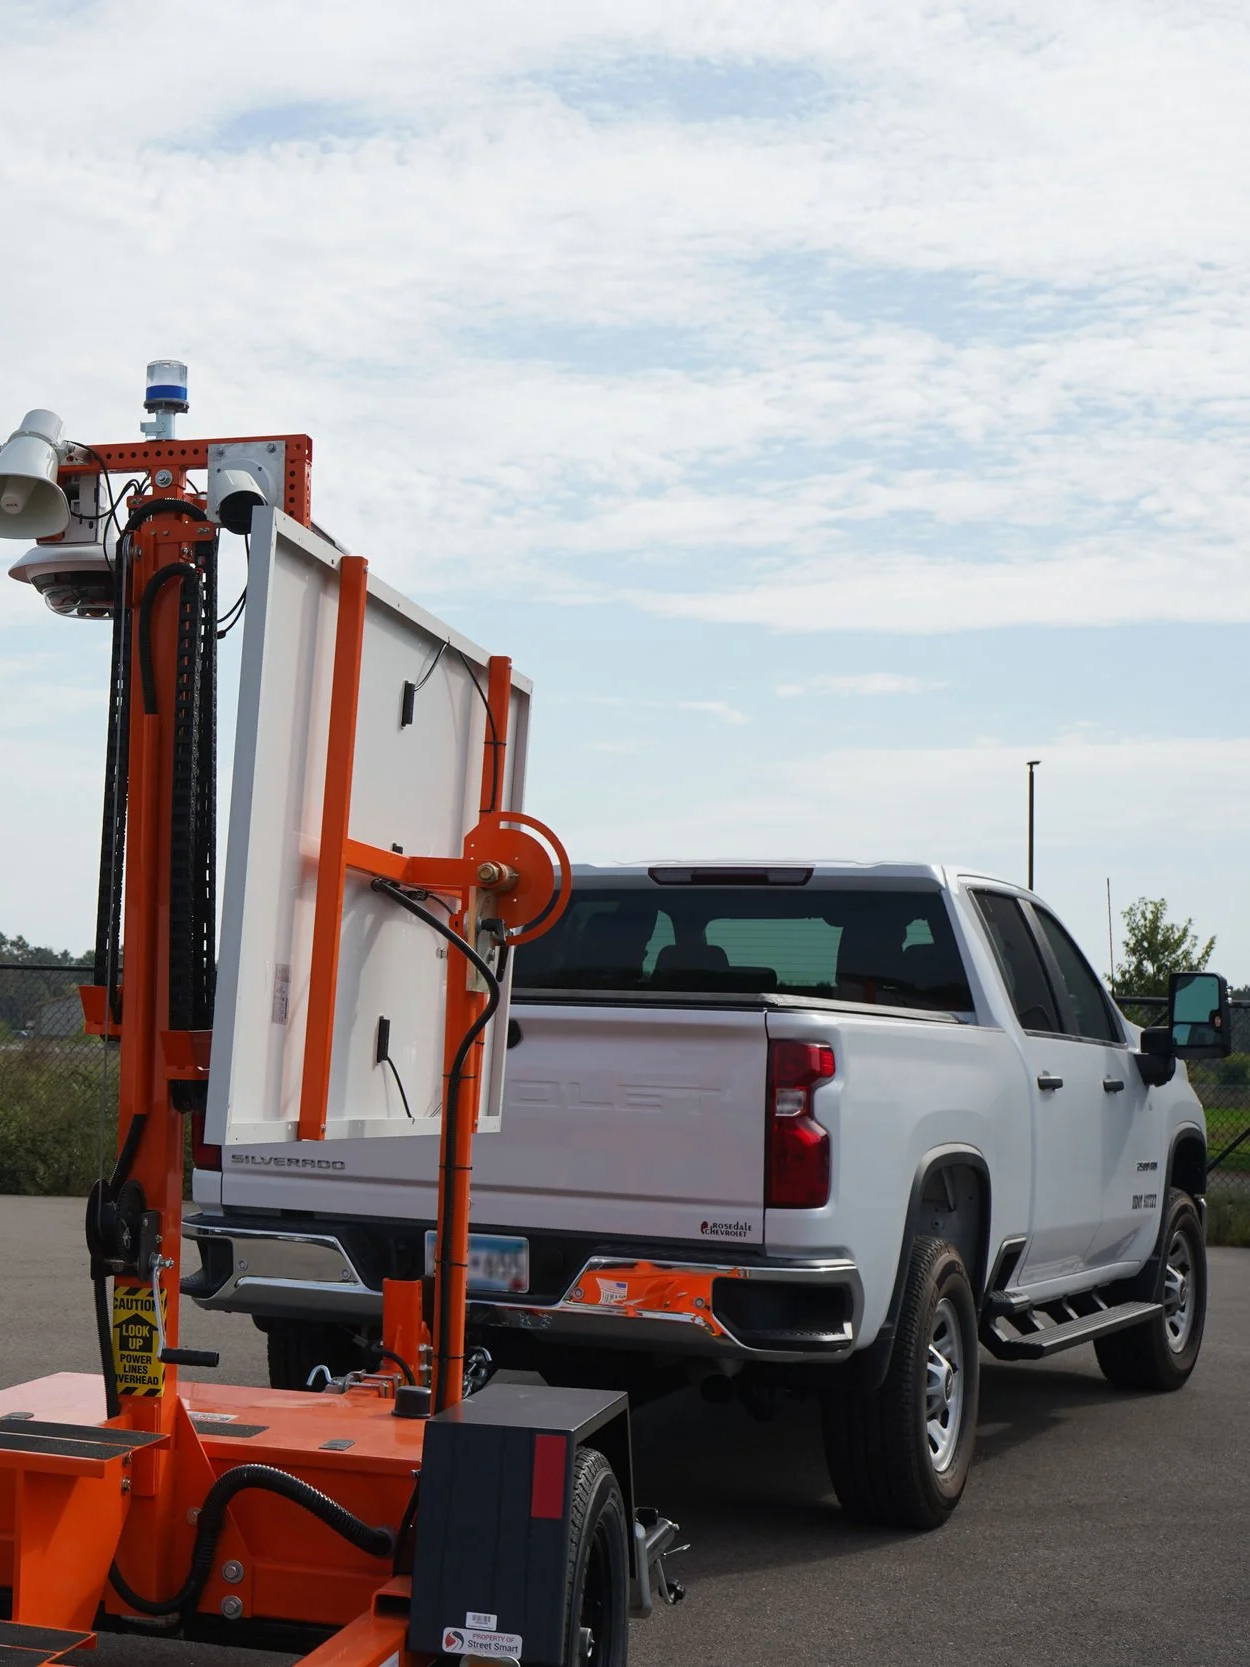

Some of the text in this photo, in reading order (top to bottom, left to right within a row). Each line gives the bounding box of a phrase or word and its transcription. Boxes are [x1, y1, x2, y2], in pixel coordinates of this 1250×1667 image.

[231, 1154, 346, 1170] SILVERADO
[122, 1324, 150, 1337] LOOK
[129, 1338, 143, 1350] UP
[120, 1353, 152, 1365] POWER
[123, 1365, 148, 1375] LINES
[116, 1374, 159, 1385] VERHEAD
[472, 1633, 505, 1642] PROPERTY
[467, 1639, 492, 1650] Street
[493, 1642, 519, 1653] Smart
